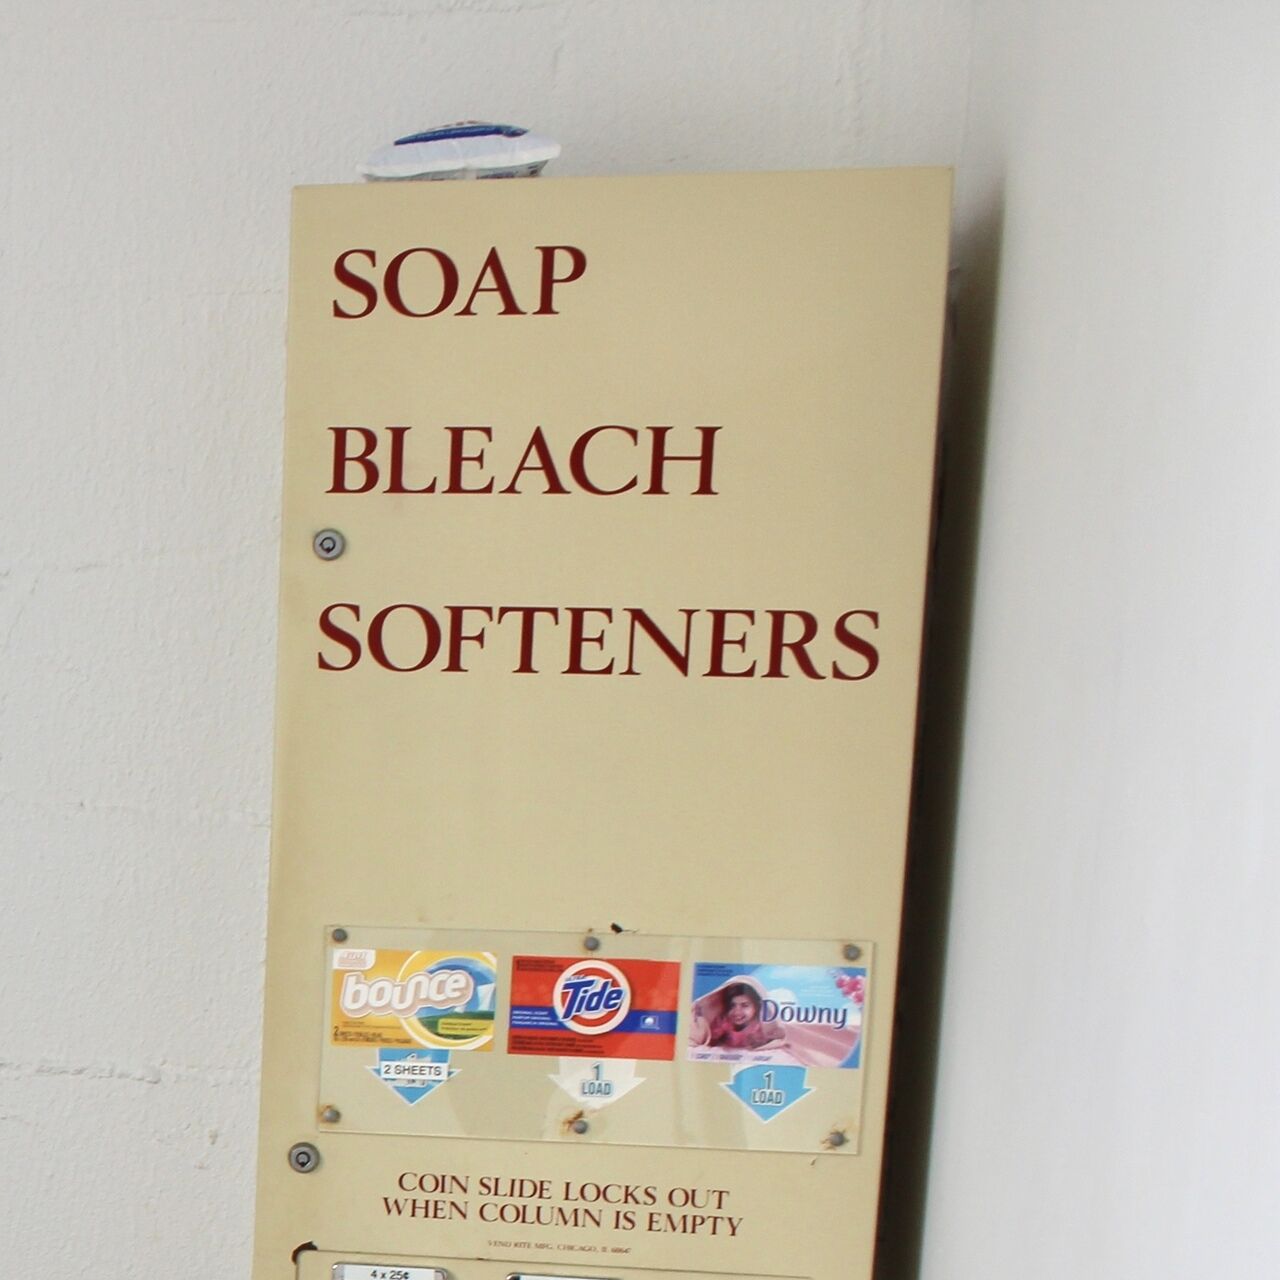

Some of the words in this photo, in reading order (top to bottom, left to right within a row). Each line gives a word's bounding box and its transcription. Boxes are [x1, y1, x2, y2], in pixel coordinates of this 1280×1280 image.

[331, 244, 588, 319] SOAP
[325, 425, 723, 497] BLEACH
[317, 602, 881, 681] SOFTENERS
[342, 971, 471, 1014] bounce
[561, 979, 624, 1021] Tide
[762, 999, 848, 1030] Downy
[383, 1064, 391, 1075] 2
[394, 1064, 443, 1076] SHEETS
[593, 1063, 602, 1081] 1
[763, 1071, 774, 1090] 1
[581, 1081, 612, 1096] LOAD
[752, 1089, 783, 1105] LOAD
[398, 1172, 469, 1195] COIN
[478, 1176, 552, 1200] SLIDE
[563, 1181, 657, 1206] LOCKS
[668, 1187, 730, 1210] OUT
[383, 1197, 469, 1220] WHEN
[479, 1202, 602, 1228] COLUMN
[613, 1210, 636, 1231] IS
[647, 1212, 744, 1237] EMPTY
[370, 1270, 377, 1278] 4
[389, 1270, 410, 1280] 25¢
